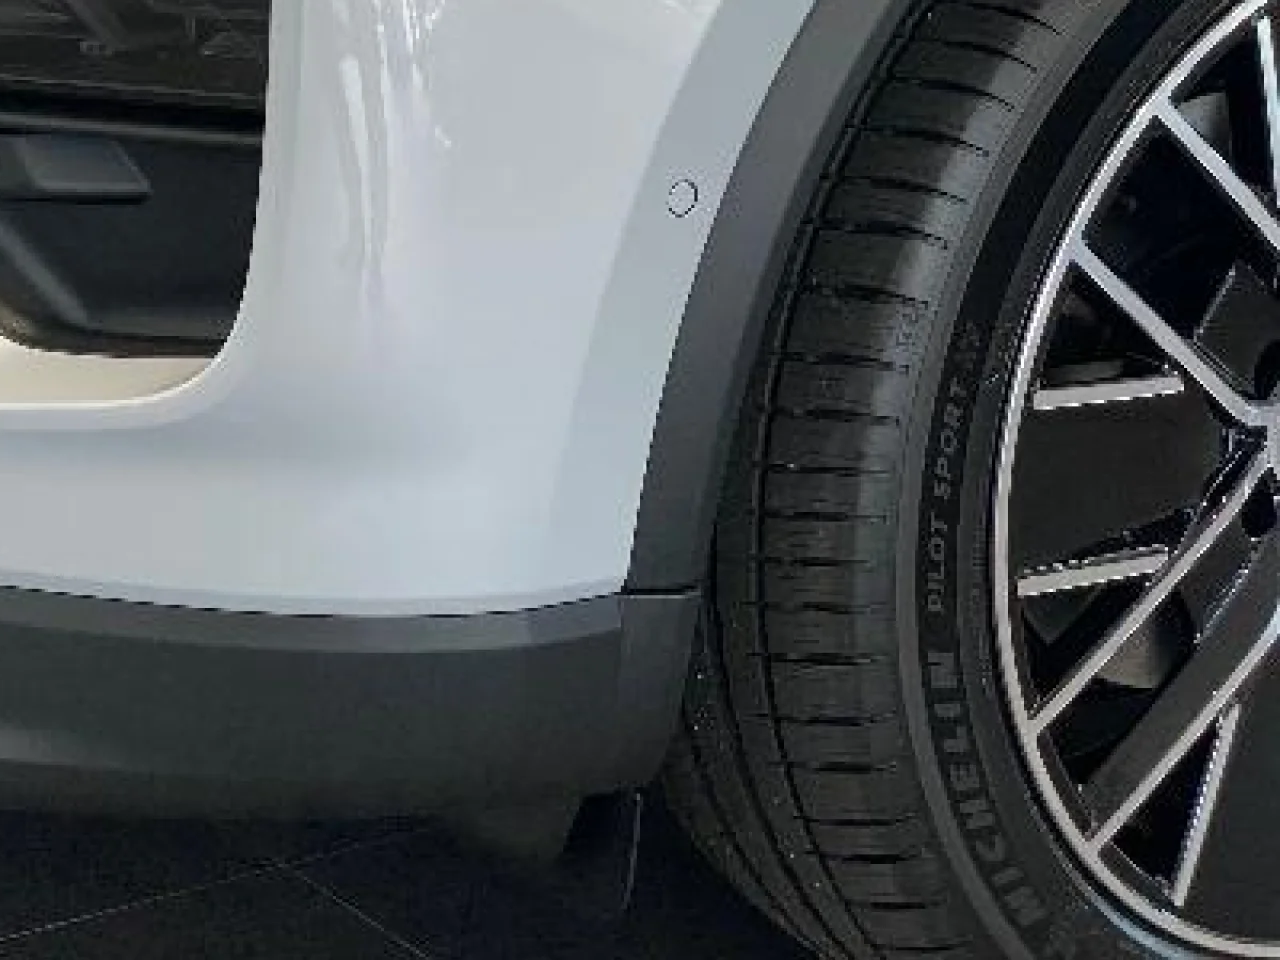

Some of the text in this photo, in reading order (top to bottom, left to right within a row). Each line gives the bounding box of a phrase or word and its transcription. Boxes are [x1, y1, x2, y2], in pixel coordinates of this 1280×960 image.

[932, 376, 966, 501] SPORT
[927, 511, 948, 613] PILOT
[927, 652, 1047, 927] MICHELIN
